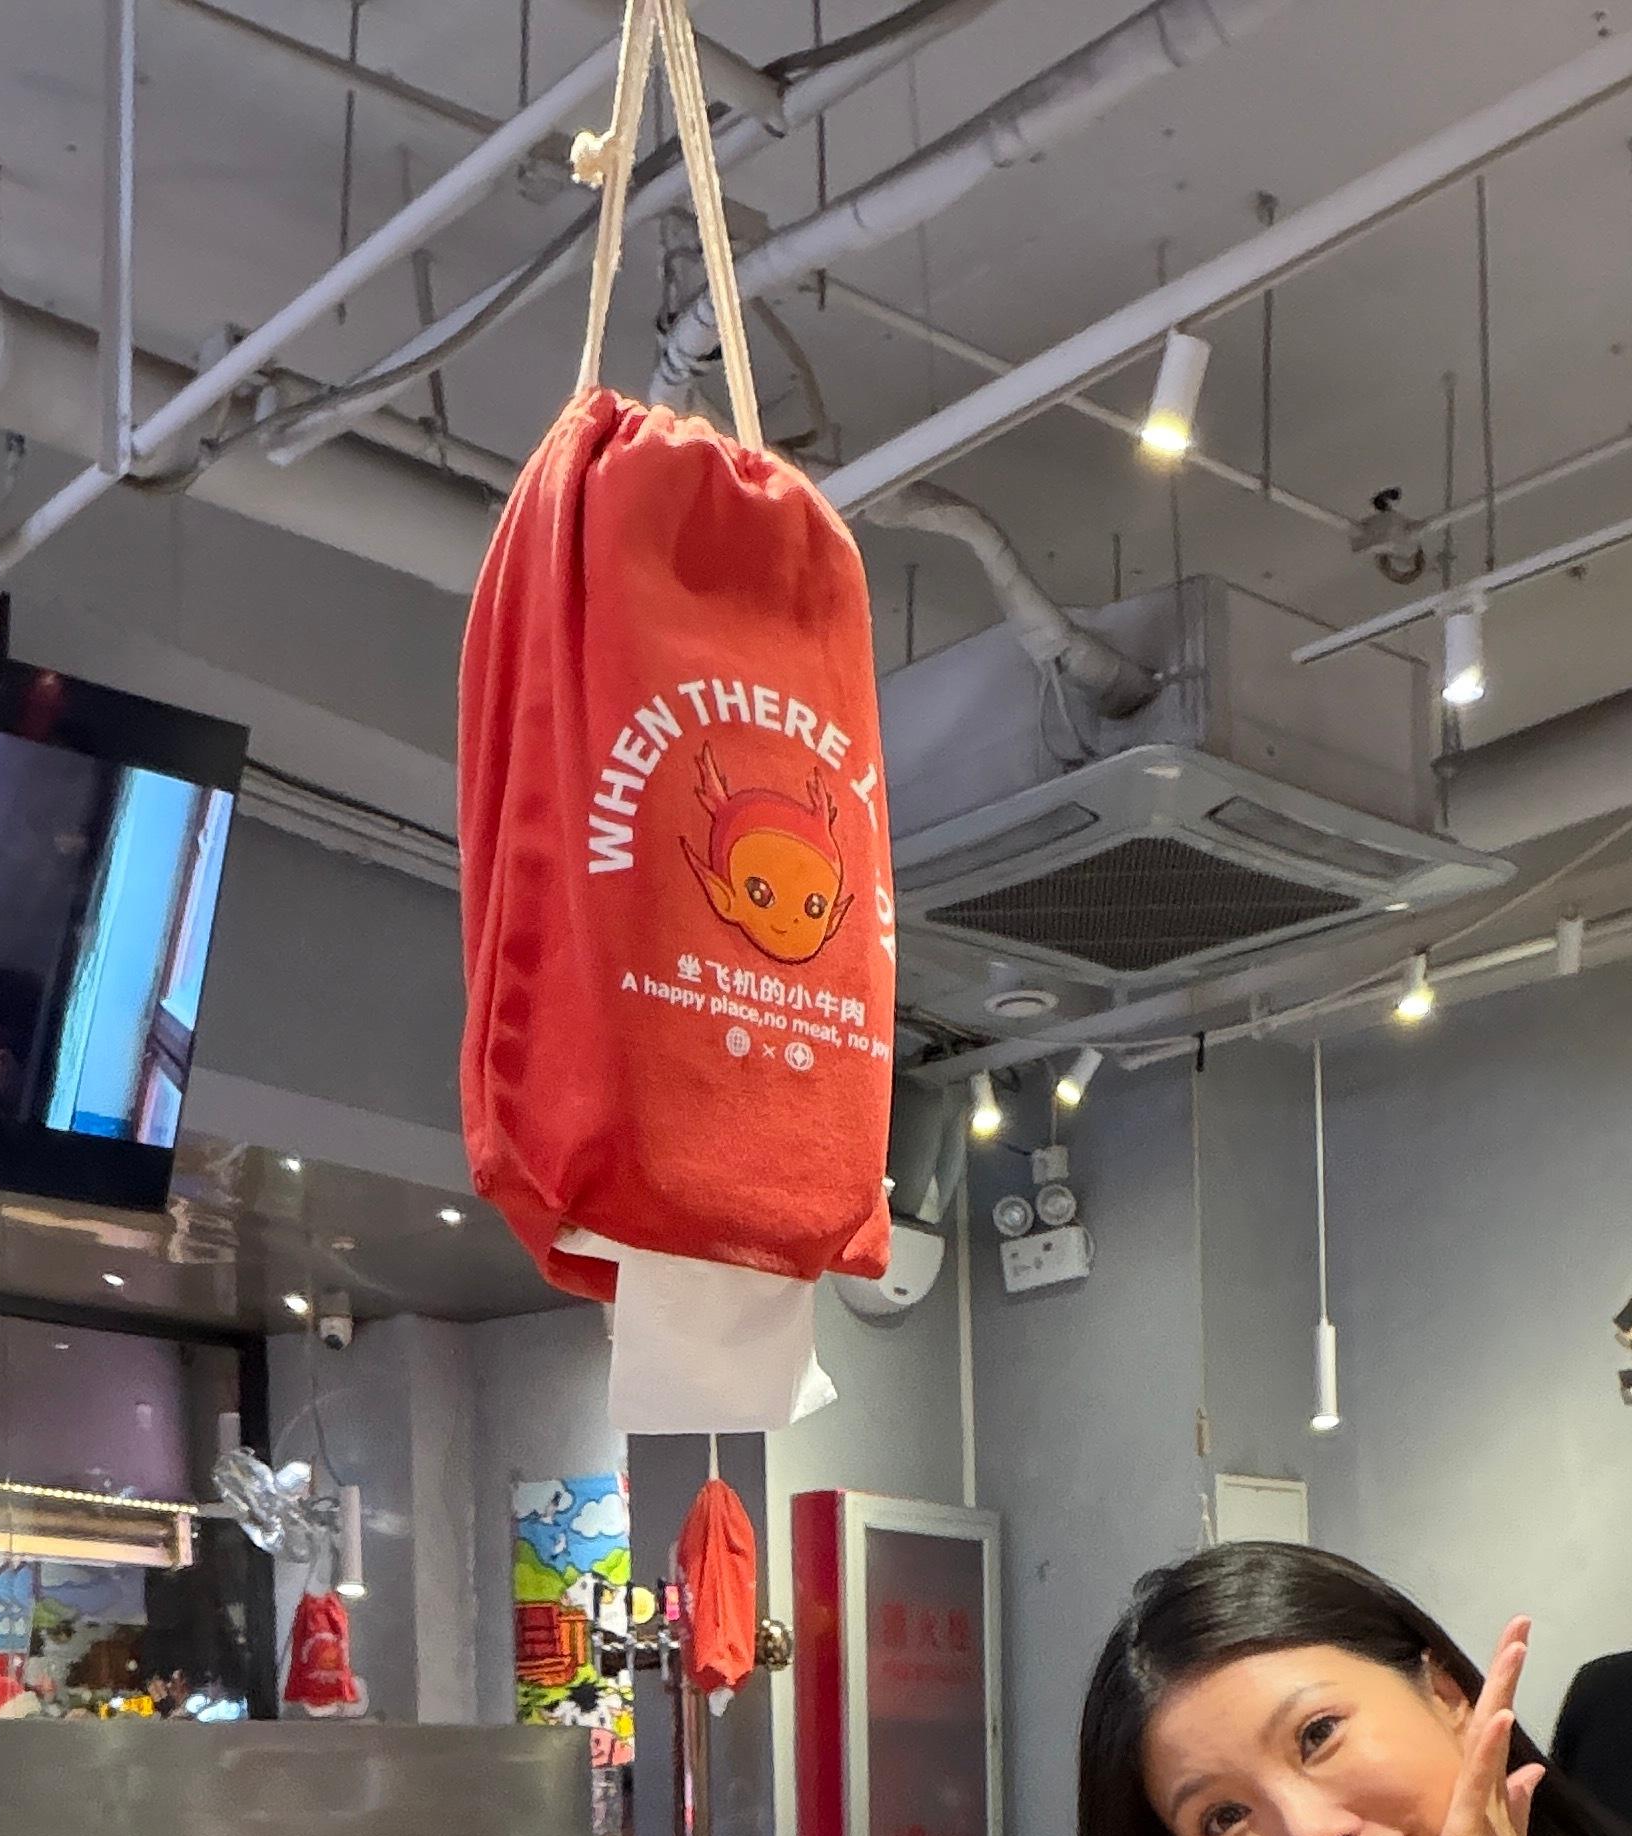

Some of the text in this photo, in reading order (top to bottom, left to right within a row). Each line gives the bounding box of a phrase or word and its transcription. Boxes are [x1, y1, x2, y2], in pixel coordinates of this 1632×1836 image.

[588, 695, 684, 874] WHEN
[677, 678, 852, 770] THERE
[621, 971, 639, 992] A
[643, 975, 706, 1012] happy
[791, 1017, 843, 1048] meat,
[847, 1032, 870, 1051] no
[676, 952, 866, 1027] 坐飞机的小牛肉
